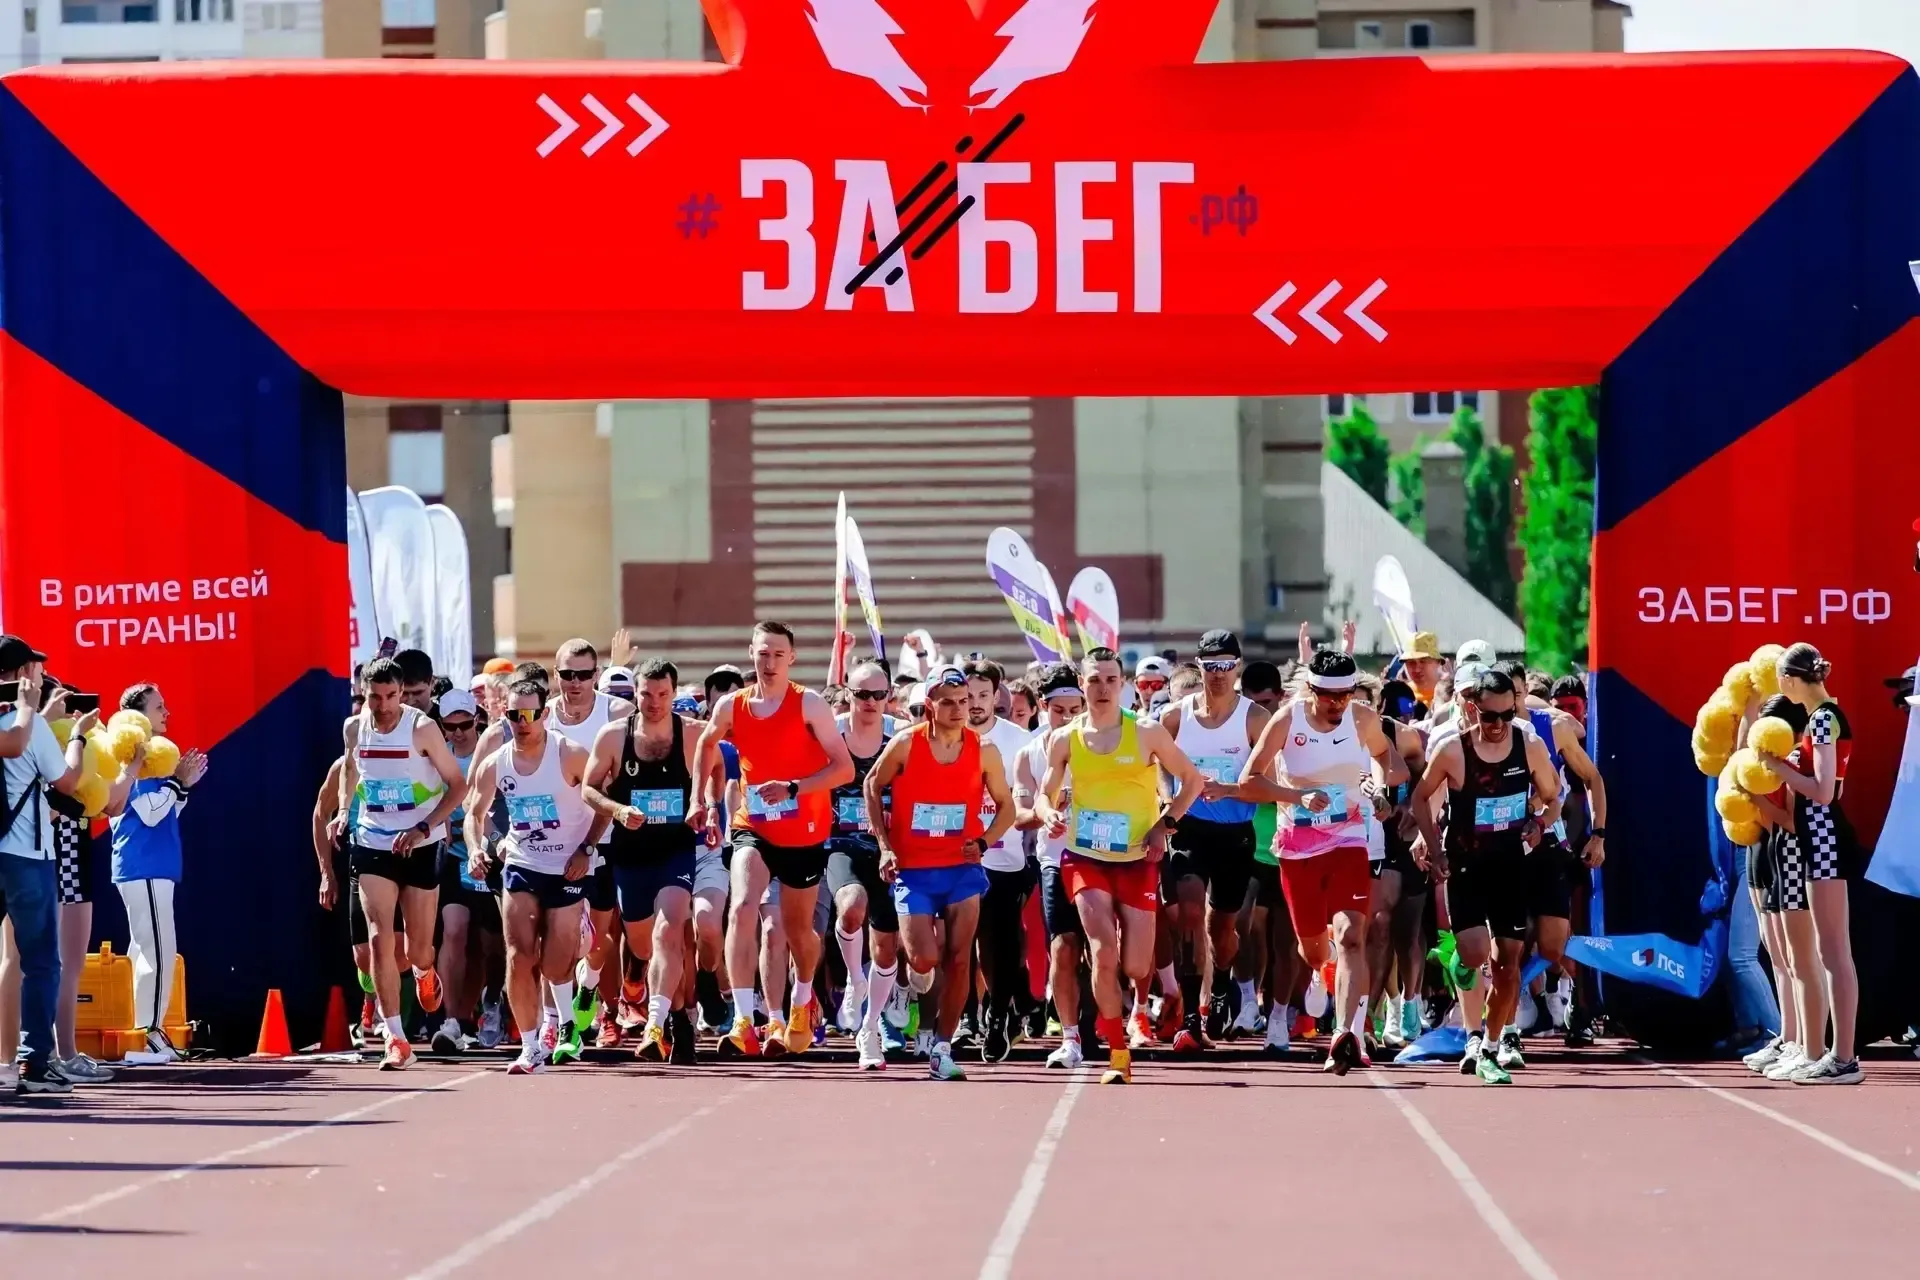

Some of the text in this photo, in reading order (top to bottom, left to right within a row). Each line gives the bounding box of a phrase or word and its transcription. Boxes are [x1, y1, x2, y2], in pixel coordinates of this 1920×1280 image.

[40, 569, 269, 611] В ритме всей
[1637, 586, 1892, 625] ЗАБЕГ.РФ
[75, 611, 237, 648] СТРАНЫ!
[1657, 952, 1685, 979] ПСБ
